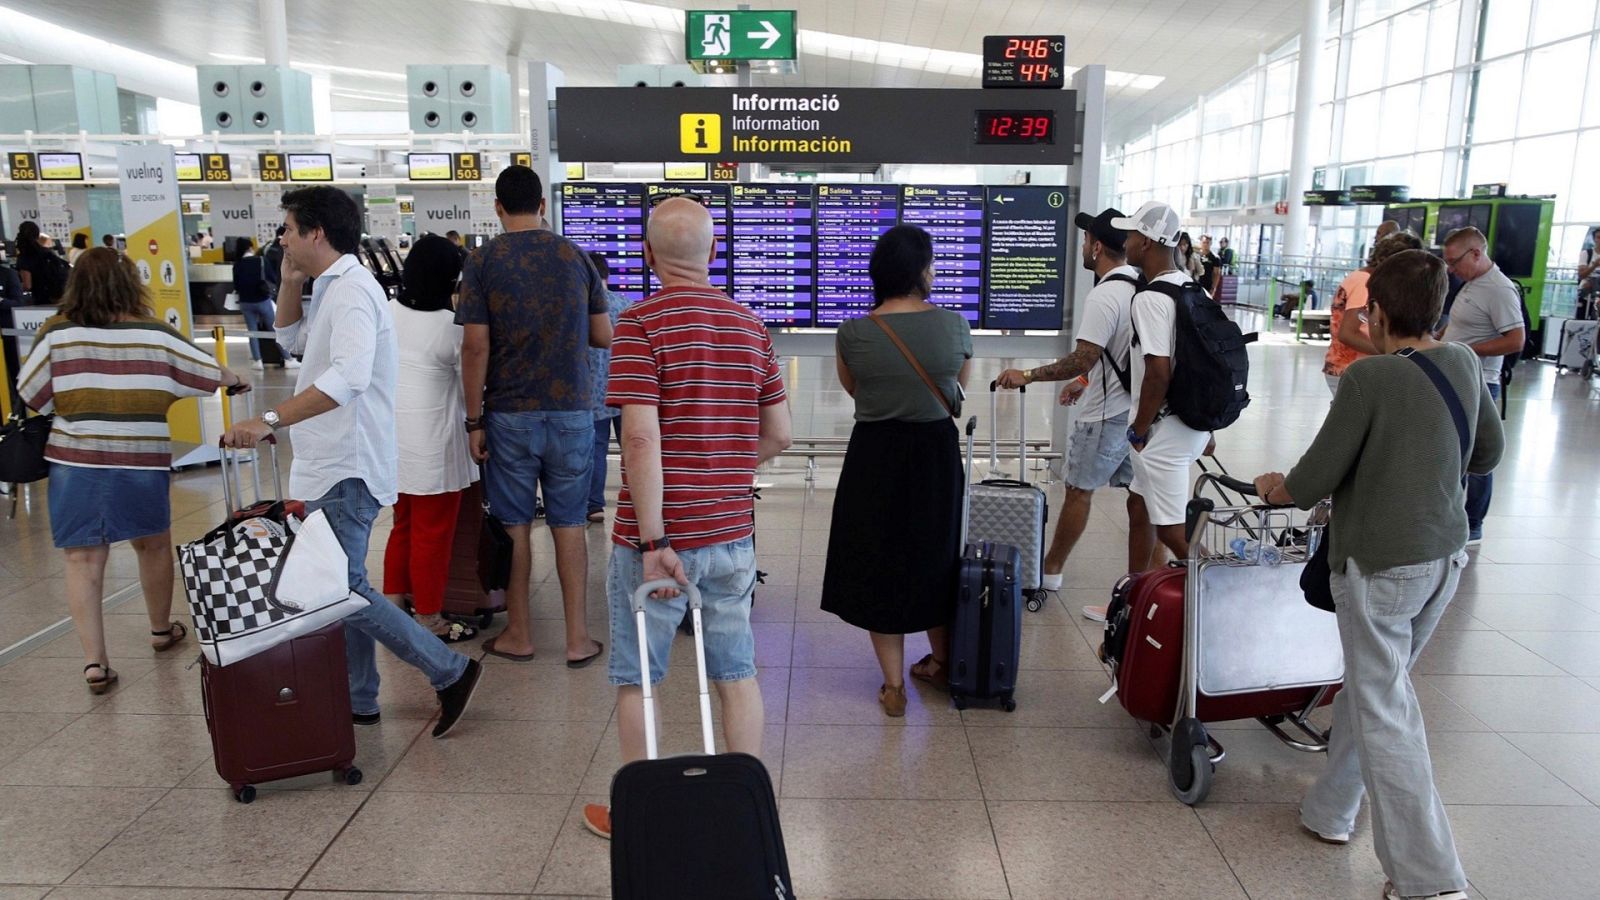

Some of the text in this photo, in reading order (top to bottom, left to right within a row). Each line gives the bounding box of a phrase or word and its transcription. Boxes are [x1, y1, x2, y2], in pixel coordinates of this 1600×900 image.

[1020, 64, 1059, 81] 44 %
[733, 93, 840, 112] Informació
[733, 116, 819, 131] Information
[990, 117, 1049, 137] 12:39
[733, 136, 851, 153] Información
[13, 169, 35, 179] 506
[126, 161, 163, 184] vueling
[207, 170, 229, 180] 505
[262, 170, 285, 180] 504
[457, 169, 479, 179] 503
[714, 169, 734, 179] 501
[223, 204, 253, 219] vuel
[427, 205, 471, 220] vuelin
